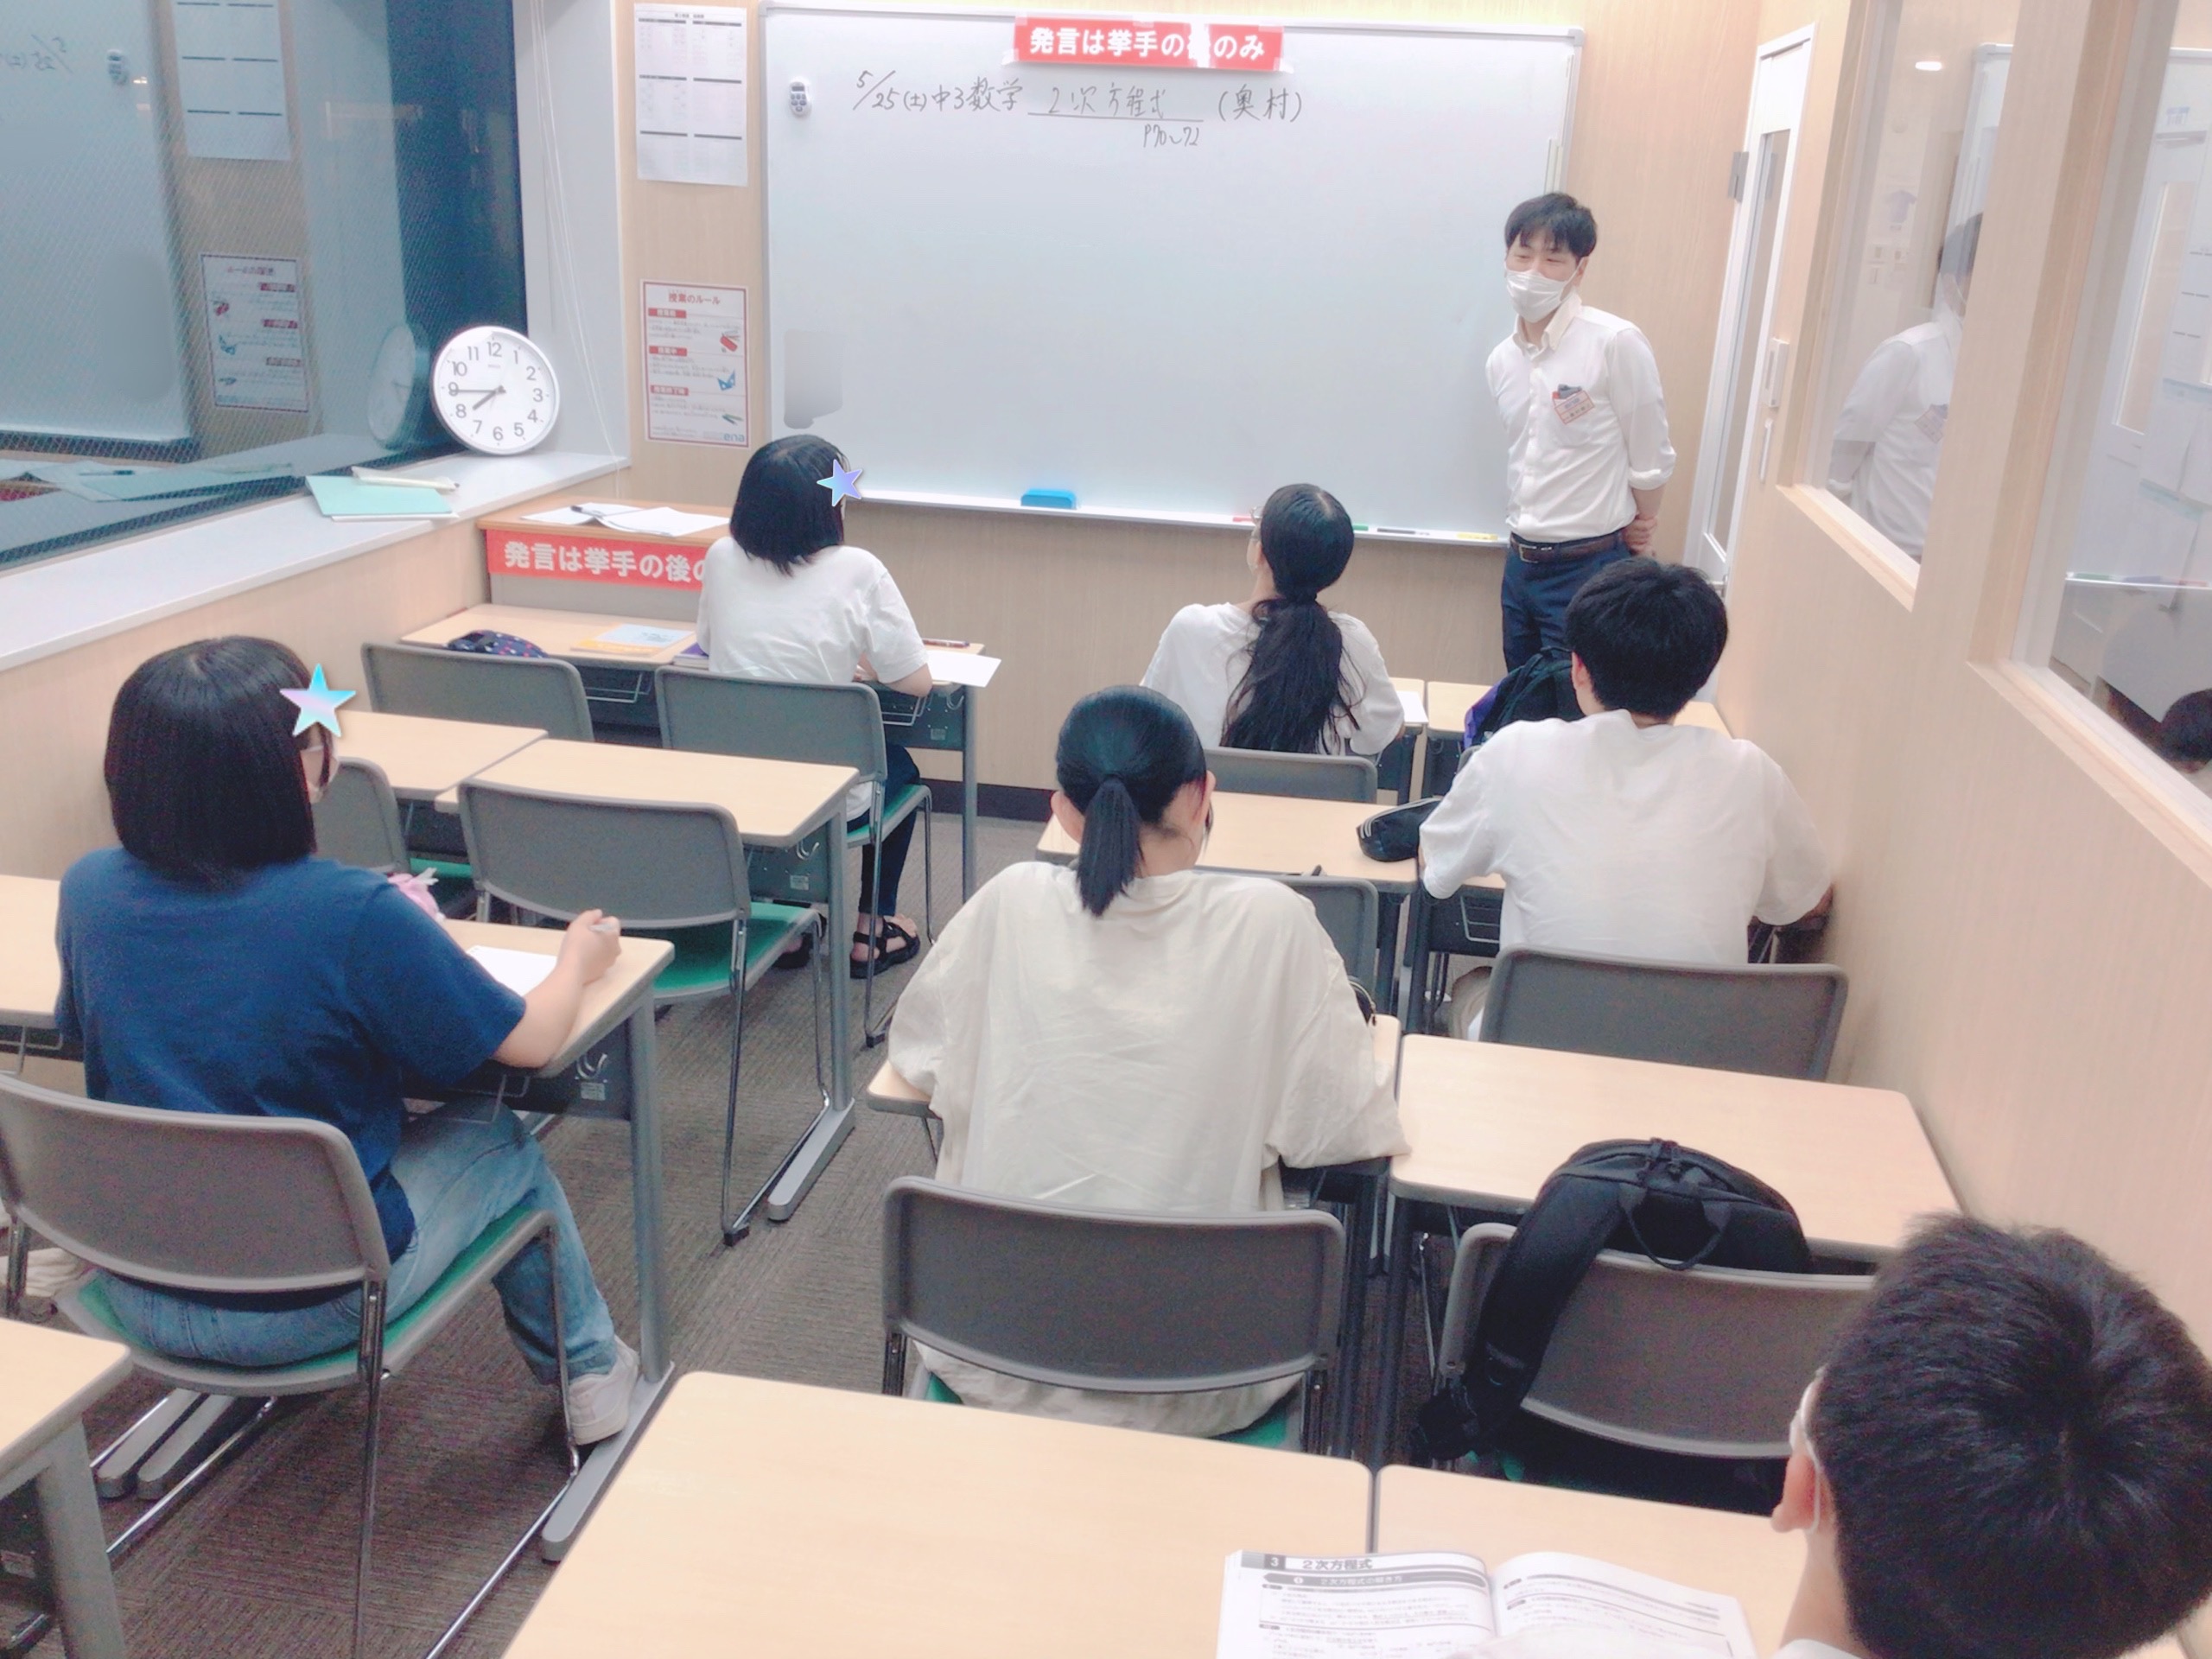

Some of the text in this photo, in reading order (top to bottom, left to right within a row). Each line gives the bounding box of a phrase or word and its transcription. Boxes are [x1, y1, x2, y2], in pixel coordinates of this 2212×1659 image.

[467, 346, 479, 360] 11
[487, 341, 502, 357] 12
[513, 350, 518, 364] 1
[452, 361, 467, 377] 10
[526, 365, 537, 381] 2
[448, 381, 459, 397] 9
[532, 388, 543, 403] 3
[455, 404, 467, 418] 8
[527, 409, 537, 423] 4
[473, 419, 482, 434] 7
[493, 426, 504, 441] 6
[513, 422, 524, 436] 5
[724, 433, 745, 442] ena
[1270, 1556, 1279, 1567] 3
[1302, 1558, 1374, 1571] 2次方程式
